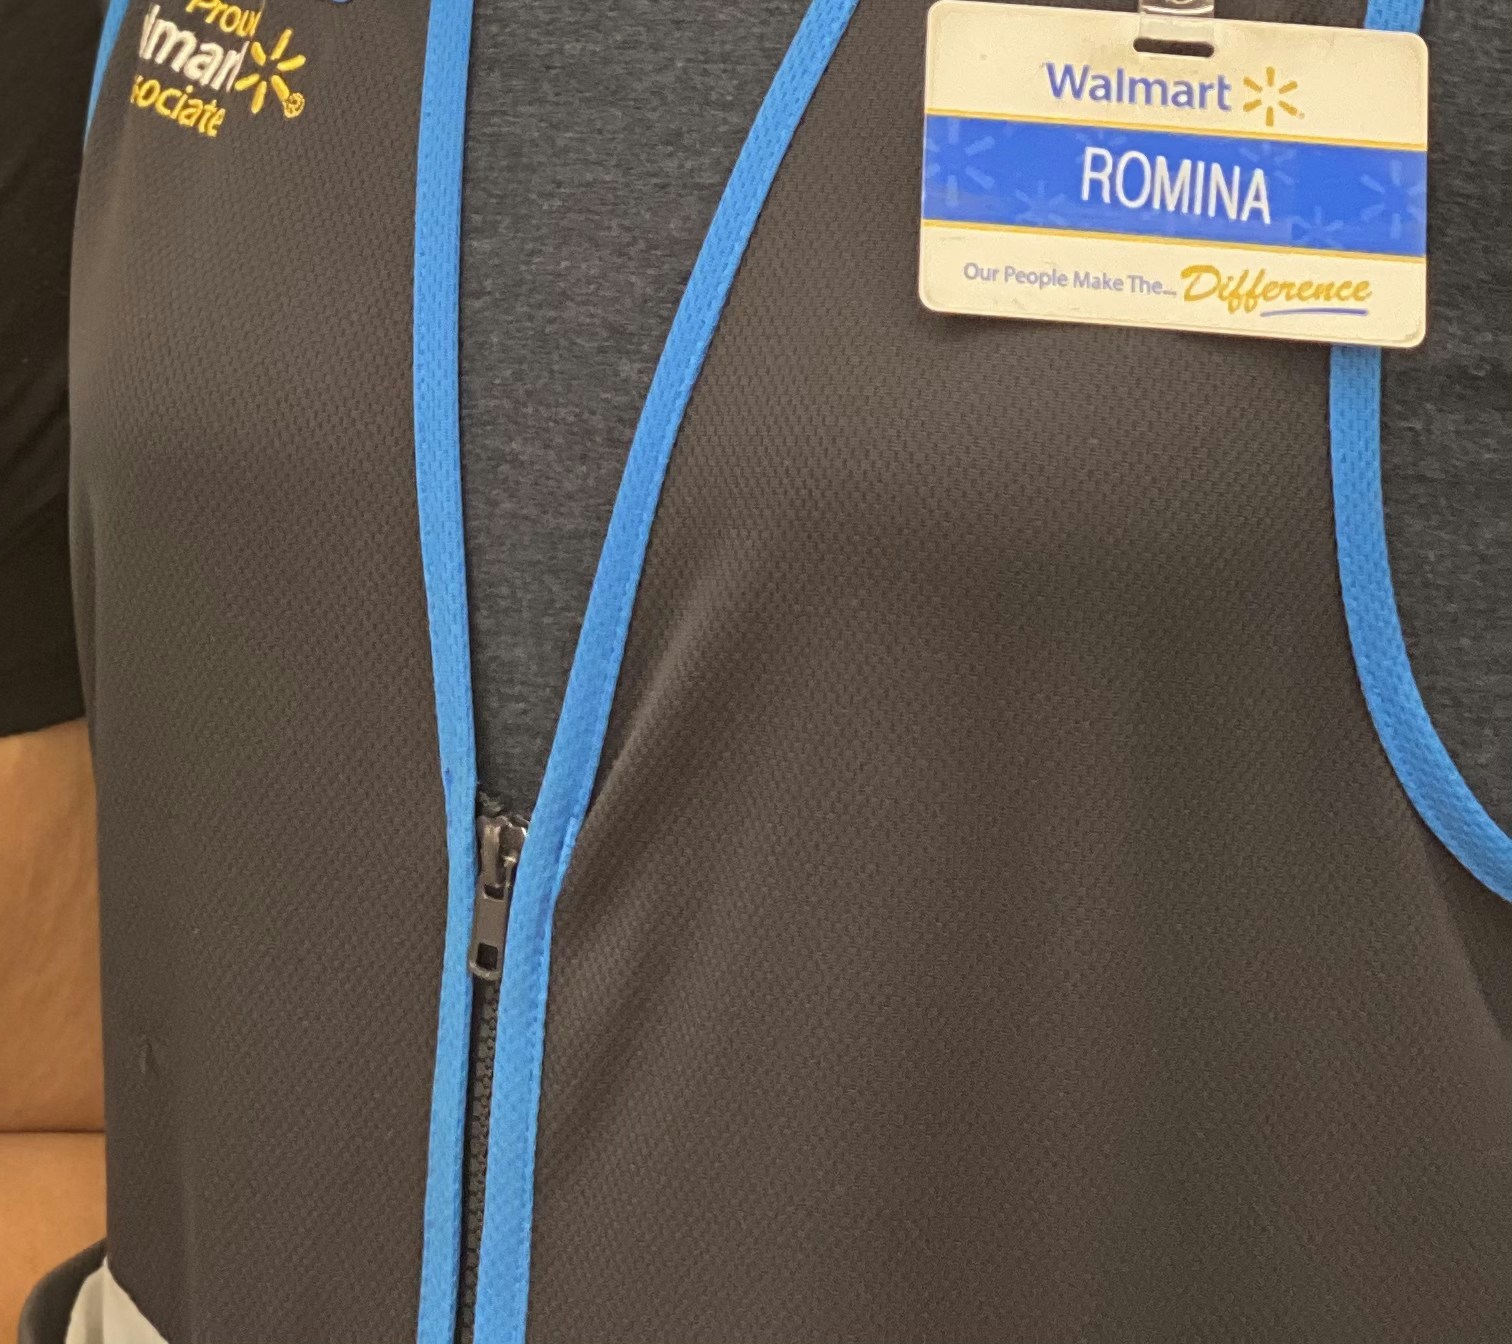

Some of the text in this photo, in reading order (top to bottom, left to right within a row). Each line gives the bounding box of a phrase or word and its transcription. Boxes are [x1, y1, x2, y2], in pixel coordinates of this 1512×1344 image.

[130, 74, 227, 138] ociate
[1044, 61, 1232, 112] Walmart
[1081, 146, 1271, 225] ROMINA
[963, 261, 999, 283] Our
[1003, 265, 1068, 290] People
[1072, 269, 1124, 292] Make
[1180, 264, 1372, 313] Difference
